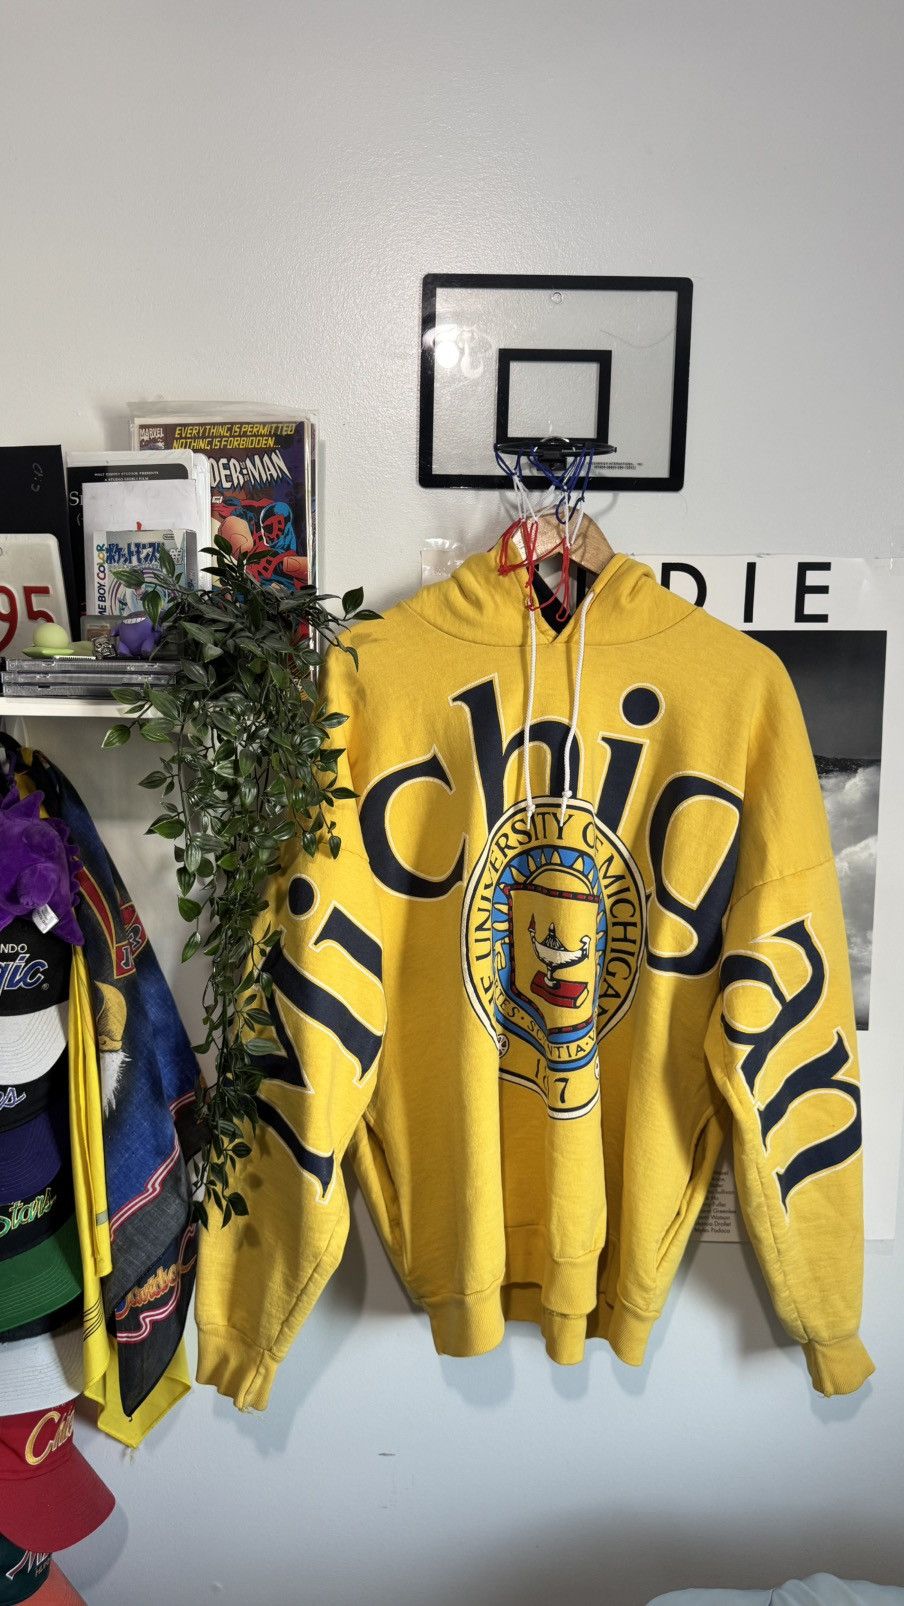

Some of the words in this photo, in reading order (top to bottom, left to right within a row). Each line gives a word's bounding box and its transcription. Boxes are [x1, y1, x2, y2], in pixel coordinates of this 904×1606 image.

[139, 428, 164, 439] MARVEL
[175, 426, 230, 438] EVERYTHING
[231, 426, 240, 437] IS
[241, 423, 296, 436] PERMITTED
[172, 438, 210, 450] NOTHING
[212, 437, 220, 449] IS
[210, 450, 292, 488] DER-MAN
[96, 544, 107, 581] COLOR
[97, 582, 107, 603] BOY
[475, 812, 574, 962] UNIVERSITY
[0, 943, 27, 953] NDO
